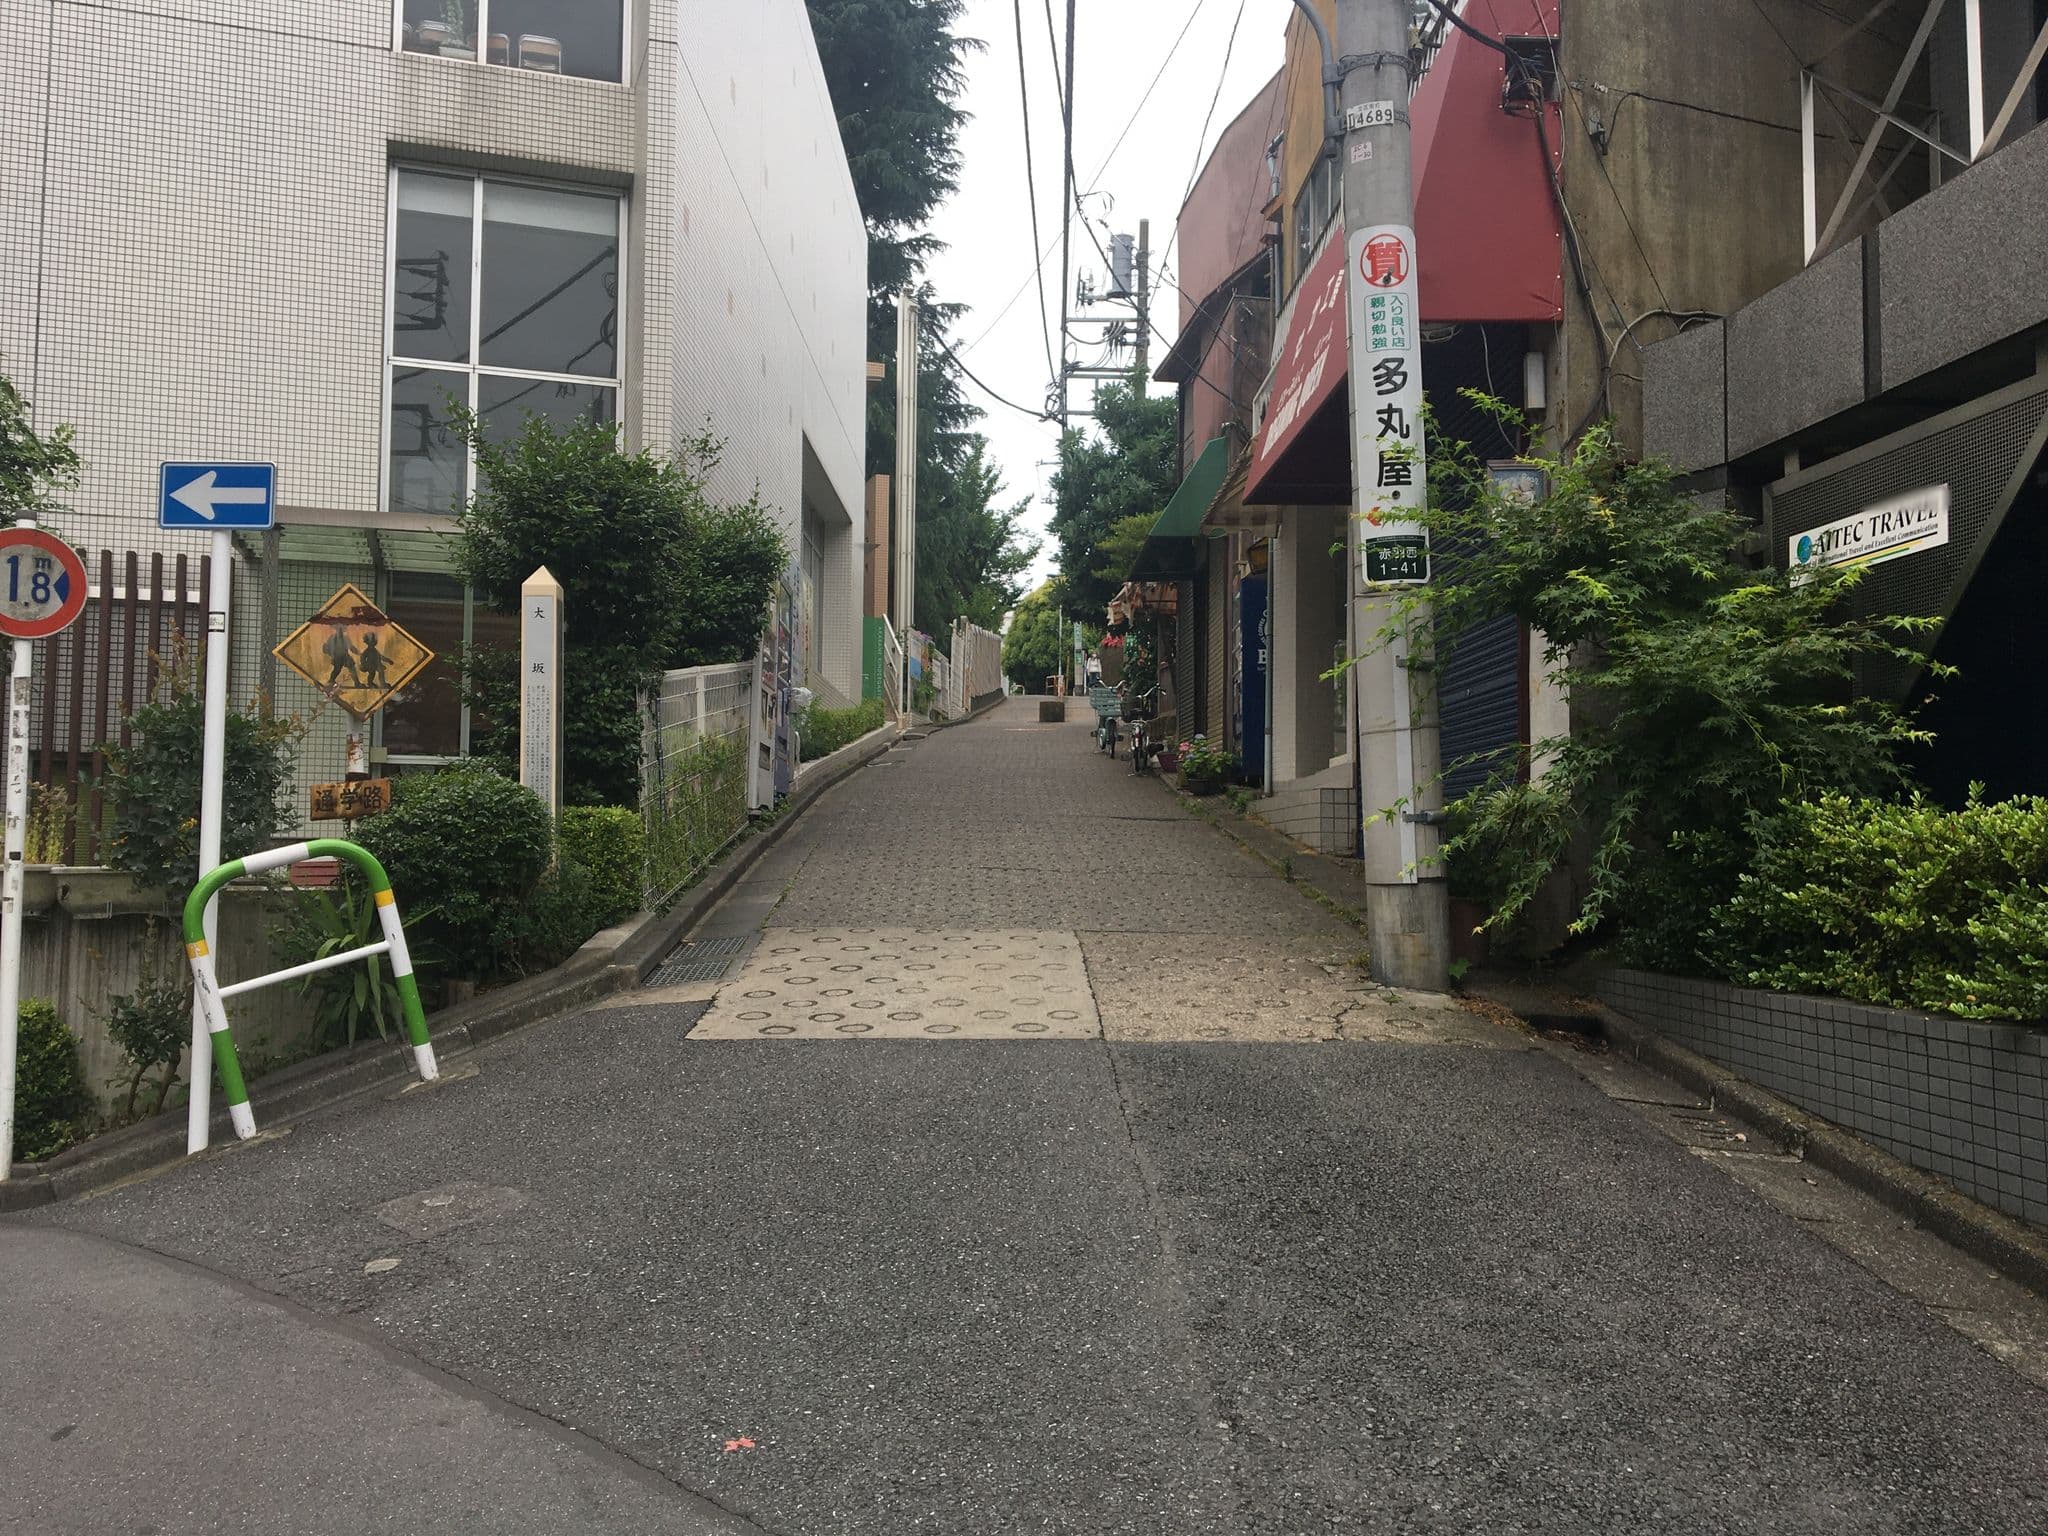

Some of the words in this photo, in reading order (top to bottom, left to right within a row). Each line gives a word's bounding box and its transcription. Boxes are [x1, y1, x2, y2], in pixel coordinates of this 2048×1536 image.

[1366, 240, 1404, 283] 質
[1370, 296, 1387, 349] 親切勉強
[1390, 295, 1405, 347] 入り良い店
[1372, 357, 1412, 487] 多丸屋
[1380, 562, 1417, 576] 1-41
[315, 786, 386, 812] 通学路
